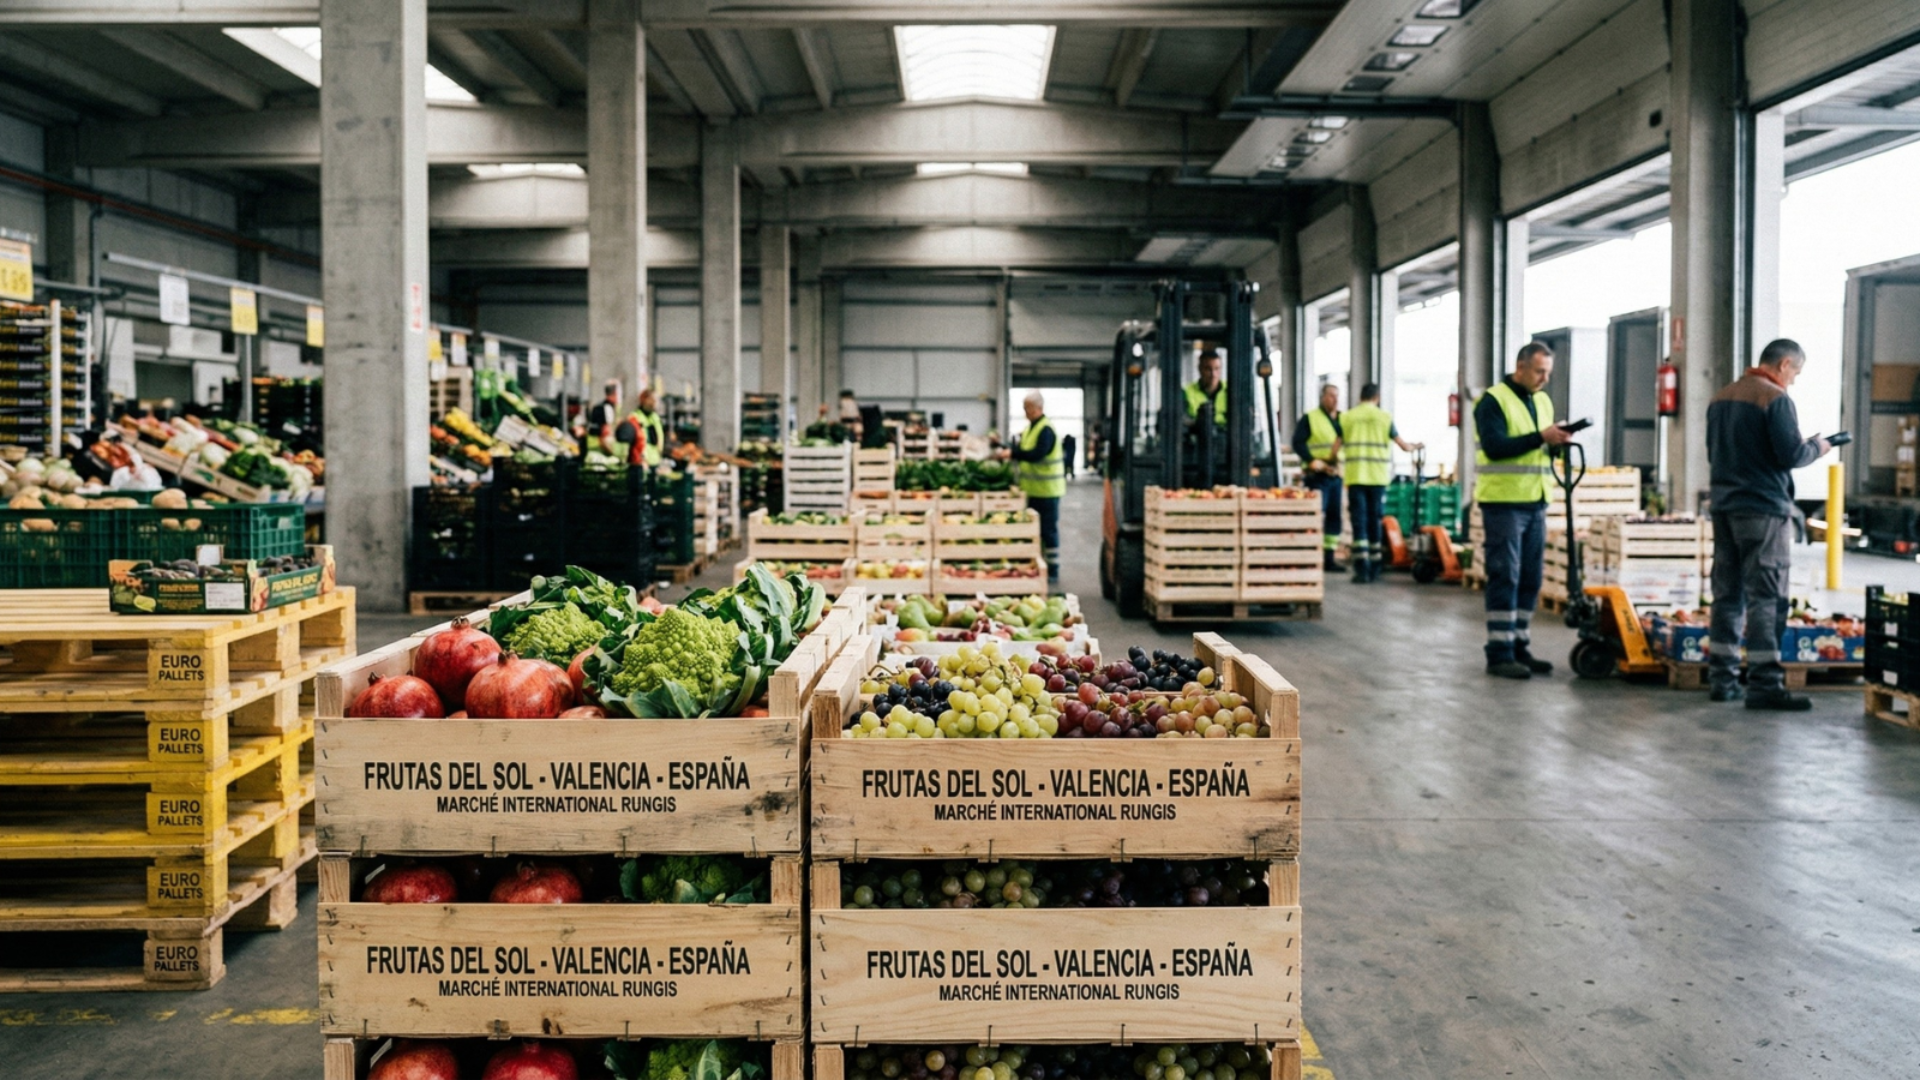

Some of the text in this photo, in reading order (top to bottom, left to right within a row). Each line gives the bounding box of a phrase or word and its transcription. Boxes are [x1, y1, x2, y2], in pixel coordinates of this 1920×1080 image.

[161, 654, 202, 669] EURO
[158, 668, 205, 682] PALLETS
[160, 727, 201, 742] EURO
[157, 742, 204, 755] PALLETS
[364, 761, 443, 791] FRUTAS
[448, 762, 488, 791] DEL
[493, 761, 534, 791] SOL
[550, 761, 652, 791] VALENCIA
[668, 755, 751, 791] ESPAÑA
[862, 769, 941, 798] FRUTAS
[947, 769, 987, 798] DEL
[991, 768, 1033, 798] SOL
[1050, 769, 1152, 798] VALENCIA
[1168, 761, 1251, 798] ESPAÑA
[160, 799, 201, 814] EURO
[436, 792, 677, 813] MARCHÉ INTERNATIONAL RUNGIS
[934, 799, 1177, 821] MARCHÉ INTERNATIONAL RUNGIS
[157, 814, 204, 827] PALLETS
[160, 872, 201, 888] EURO
[157, 887, 204, 900] PALLETS
[155, 945, 199, 961] EURO
[367, 945, 445, 975] FRUTAS
[450, 946, 490, 974] DEL
[494, 946, 536, 975] SOL
[552, 946, 652, 975] VALENCIA
[669, 940, 751, 975] ESPAÑA
[867, 949, 946, 979] FRUTAS
[951, 949, 992, 978] DEL
[996, 949, 1038, 979] SOL
[1054, 948, 1155, 978] VALENCIA
[1172, 941, 1253, 978] ESPAÑA
[154, 960, 200, 973] PALLETS
[438, 976, 678, 997] MARCHÉ INTERNATIONAL RUNGIS
[939, 980, 1180, 1001] MARCHÉ INTERNATIONAL RUNGIS
